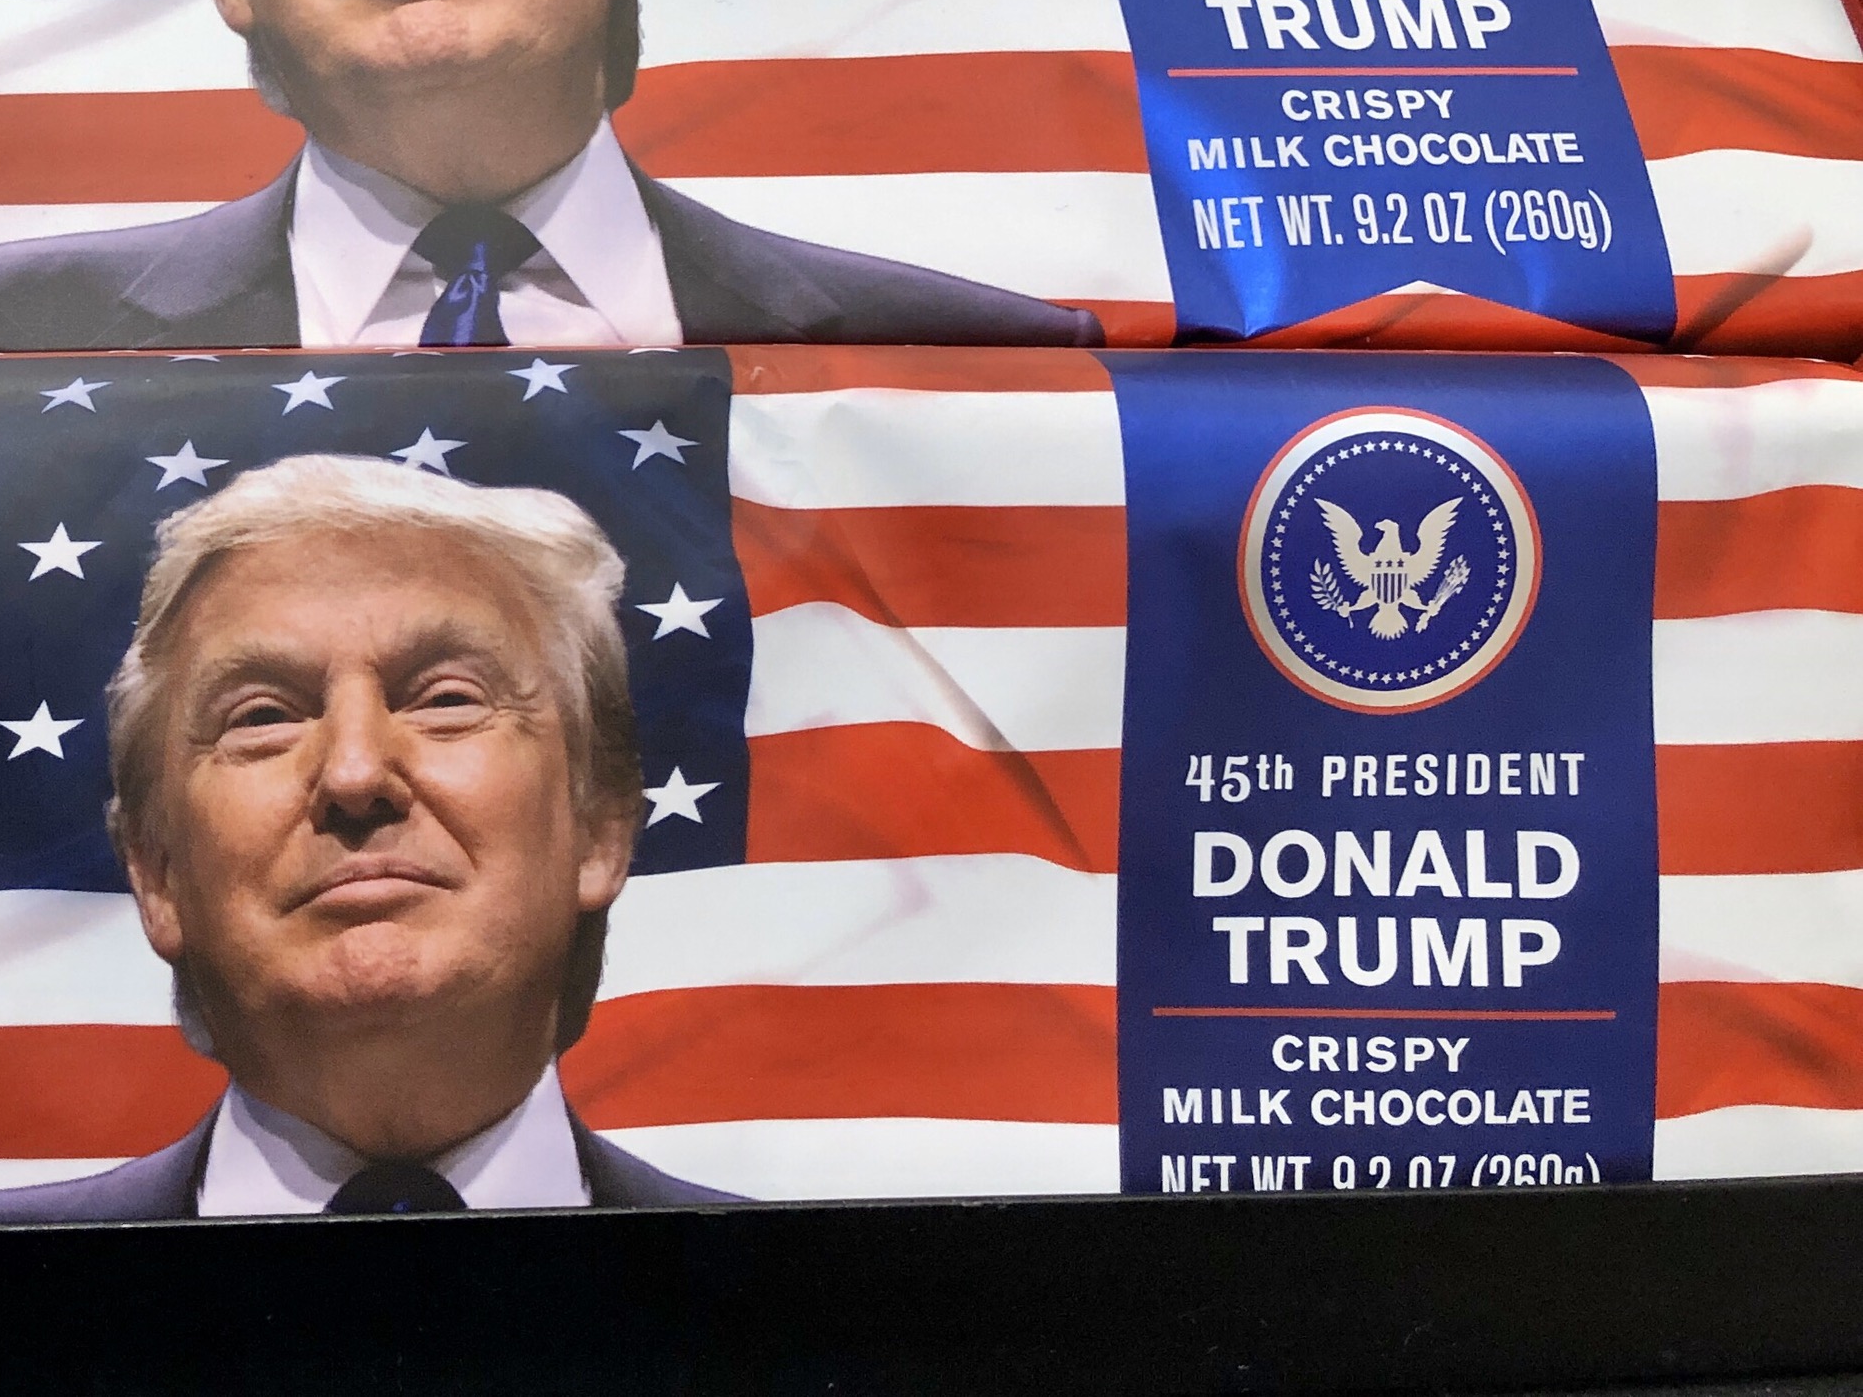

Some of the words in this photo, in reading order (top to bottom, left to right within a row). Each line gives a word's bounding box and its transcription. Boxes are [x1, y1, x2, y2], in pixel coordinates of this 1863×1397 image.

[1281, 89, 1454, 121] CRISPY
[1187, 134, 1309, 171] MILK
[1324, 132, 1584, 169] CHOCOLATE
[1193, 195, 1264, 251] NET
[1277, 193, 1344, 248] WT.
[1354, 192, 1413, 245] 9.2
[1424, 191, 1473, 244] OZ
[1484, 188, 1613, 256] (260g)
[1185, 753, 1294, 803] 45th
[1321, 752, 1585, 798] PRESIDENT
[1192, 829, 1581, 900] DONALD
[1212, 916, 1562, 988] TRUMP
[1271, 1034, 1470, 1073] CRISPY
[1162, 1087, 1293, 1125] MILK
[1310, 1088, 1591, 1126] CHOCOLATE
